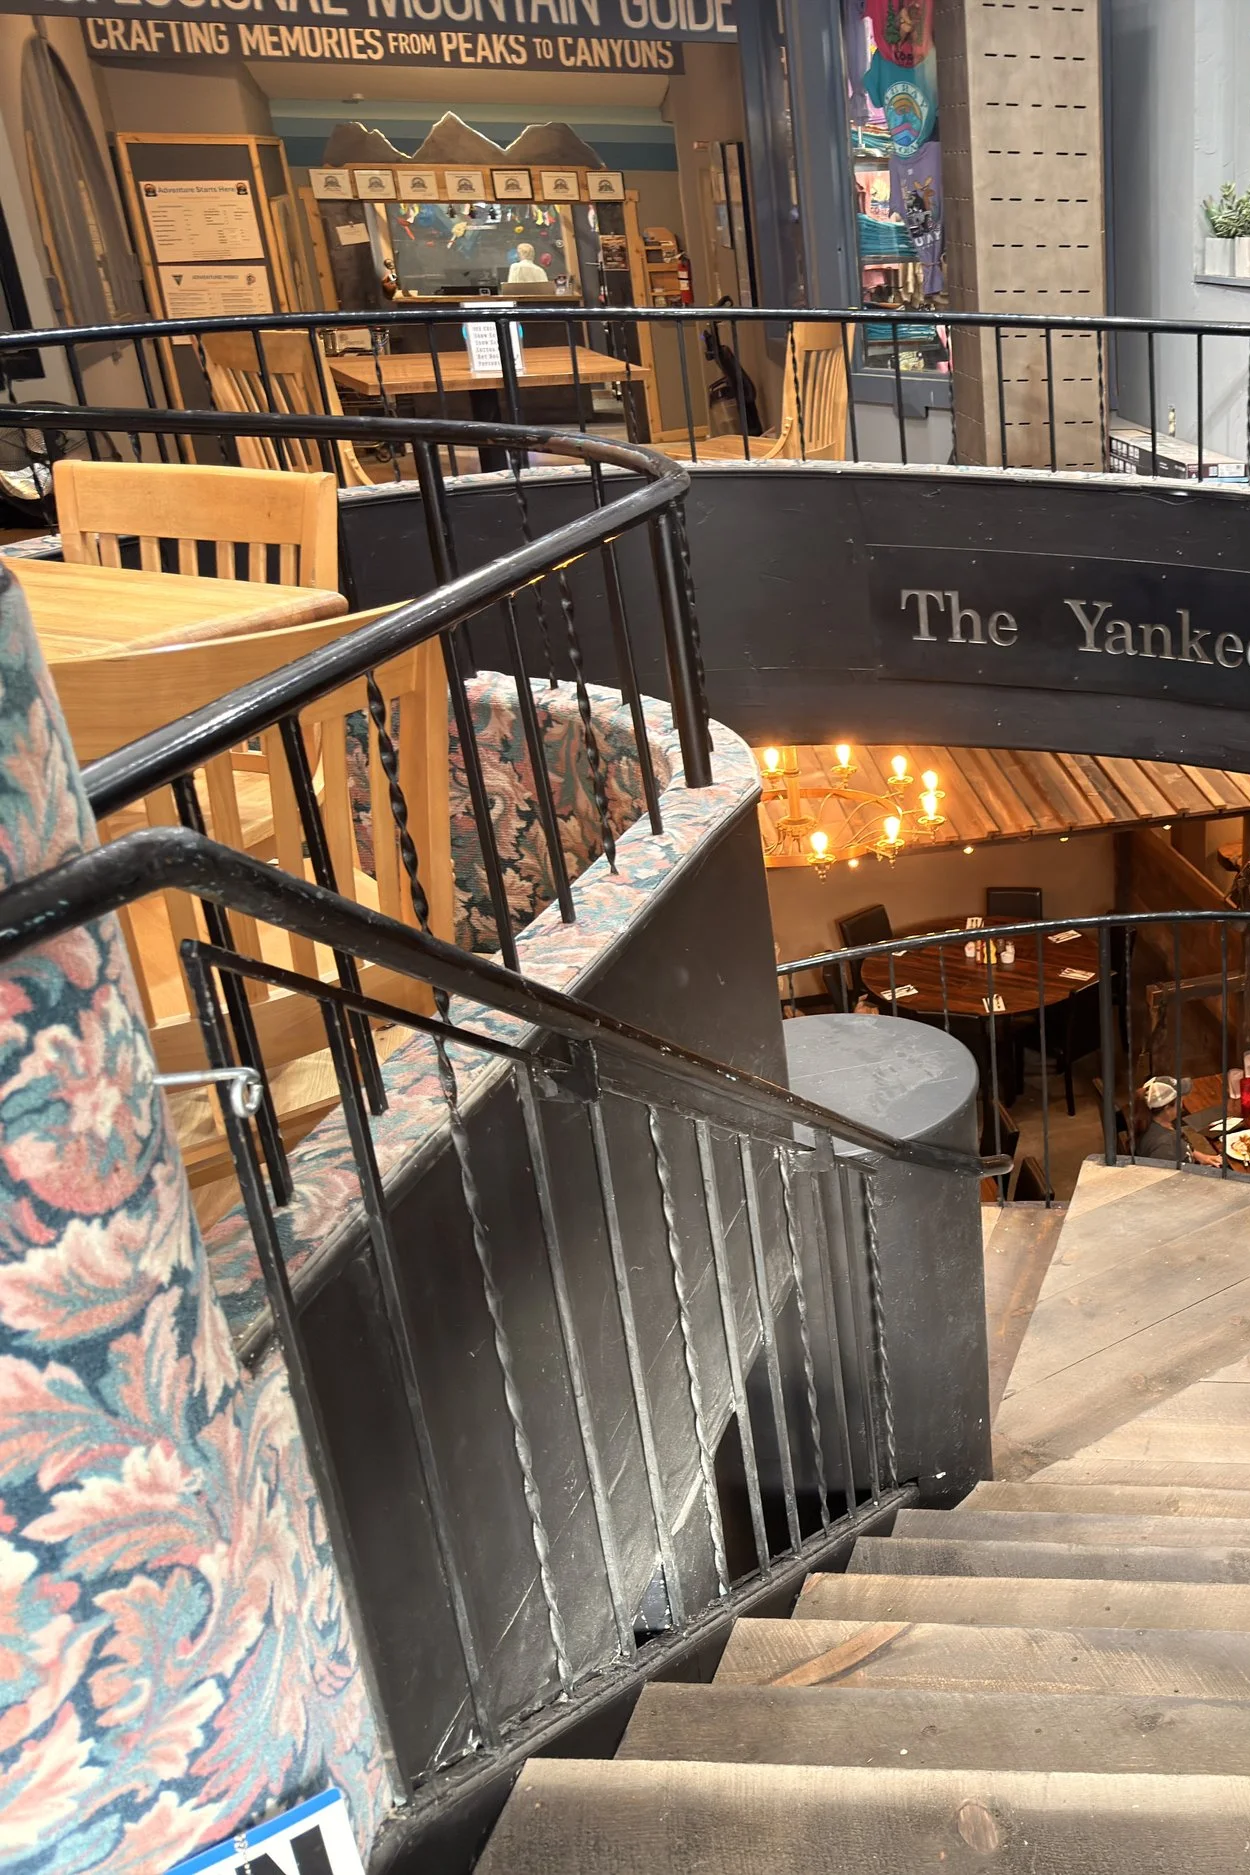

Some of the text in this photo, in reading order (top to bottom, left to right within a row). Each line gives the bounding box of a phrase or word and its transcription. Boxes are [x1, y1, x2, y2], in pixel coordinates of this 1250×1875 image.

[86, 17, 674, 69] CRAFTING MEMORIES FROM PEAKS TO CANYONS
[901, 590, 1019, 646] The
